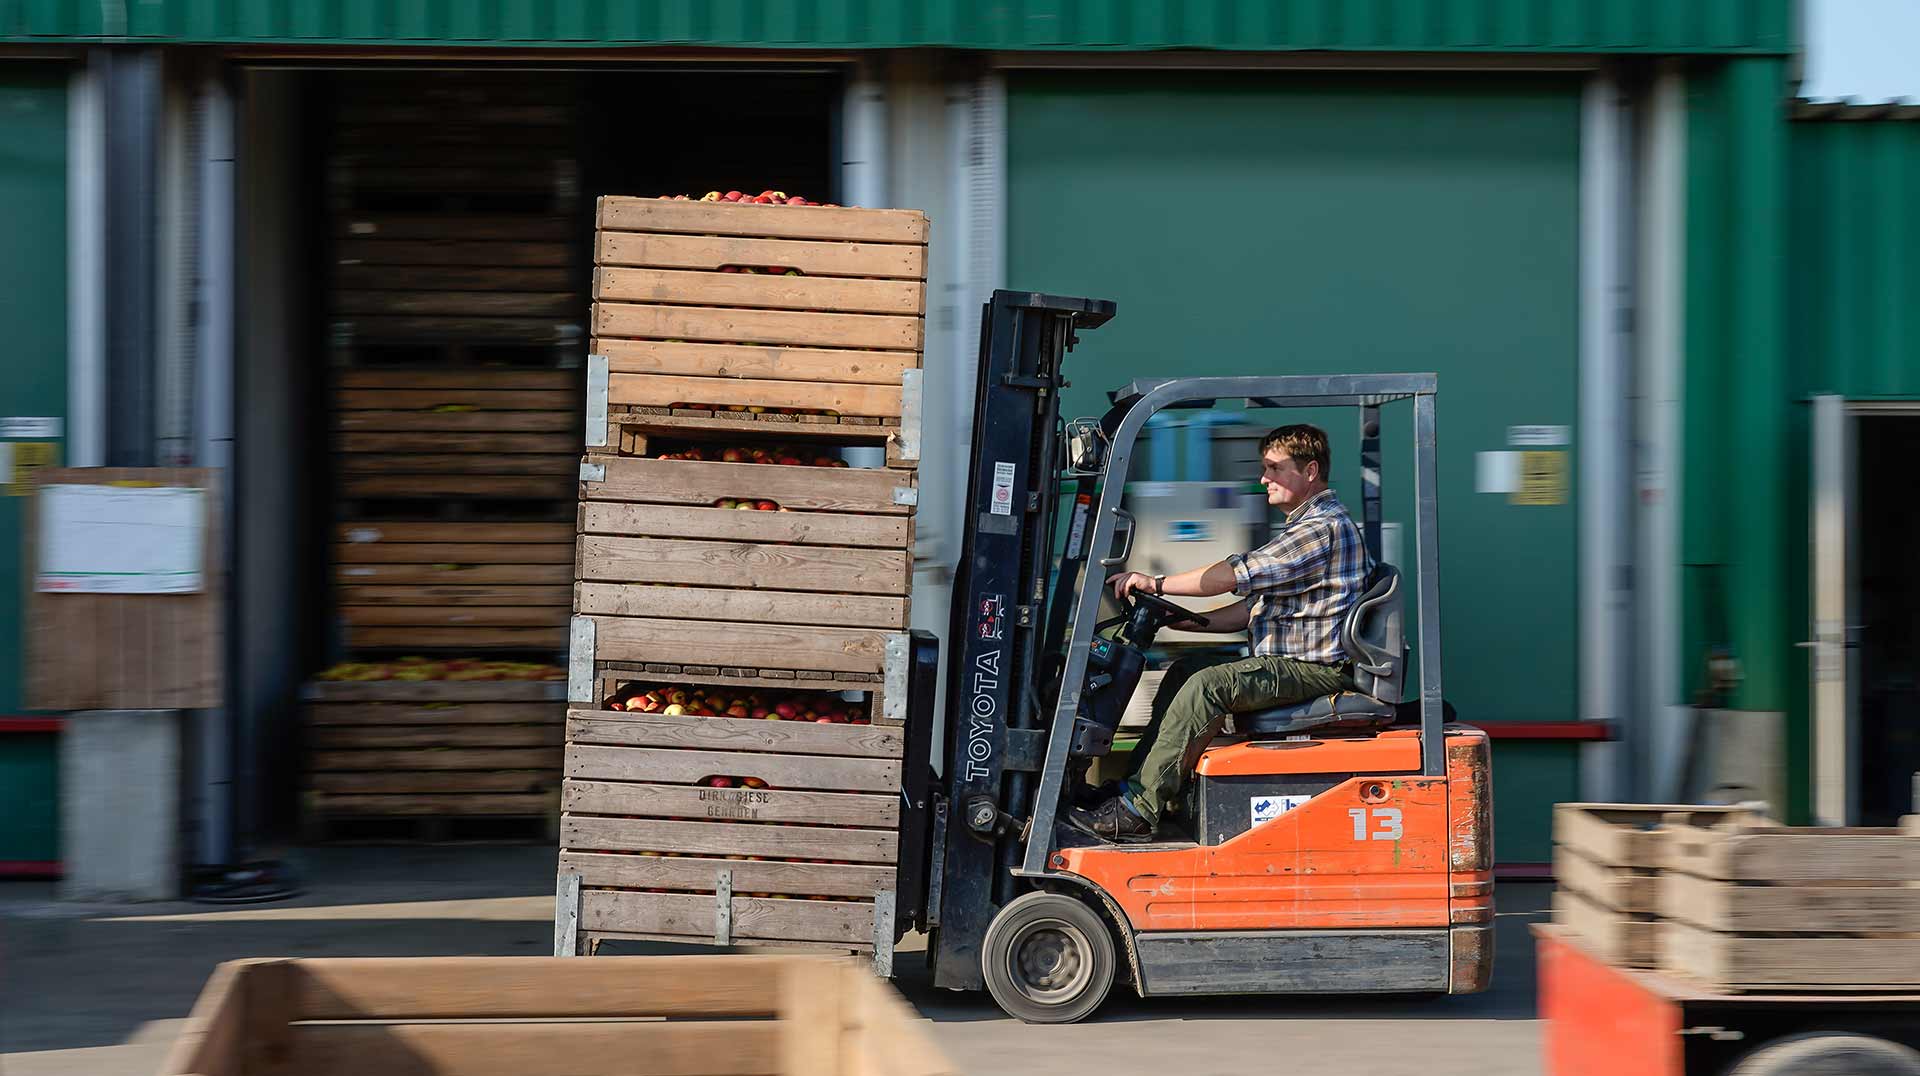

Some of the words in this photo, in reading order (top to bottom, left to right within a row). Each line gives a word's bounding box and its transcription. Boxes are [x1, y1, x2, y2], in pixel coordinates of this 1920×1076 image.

[965, 649, 1001, 781] TOYOTA
[736, 791, 769, 804] GIESE
[1348, 807, 1404, 841] 13
